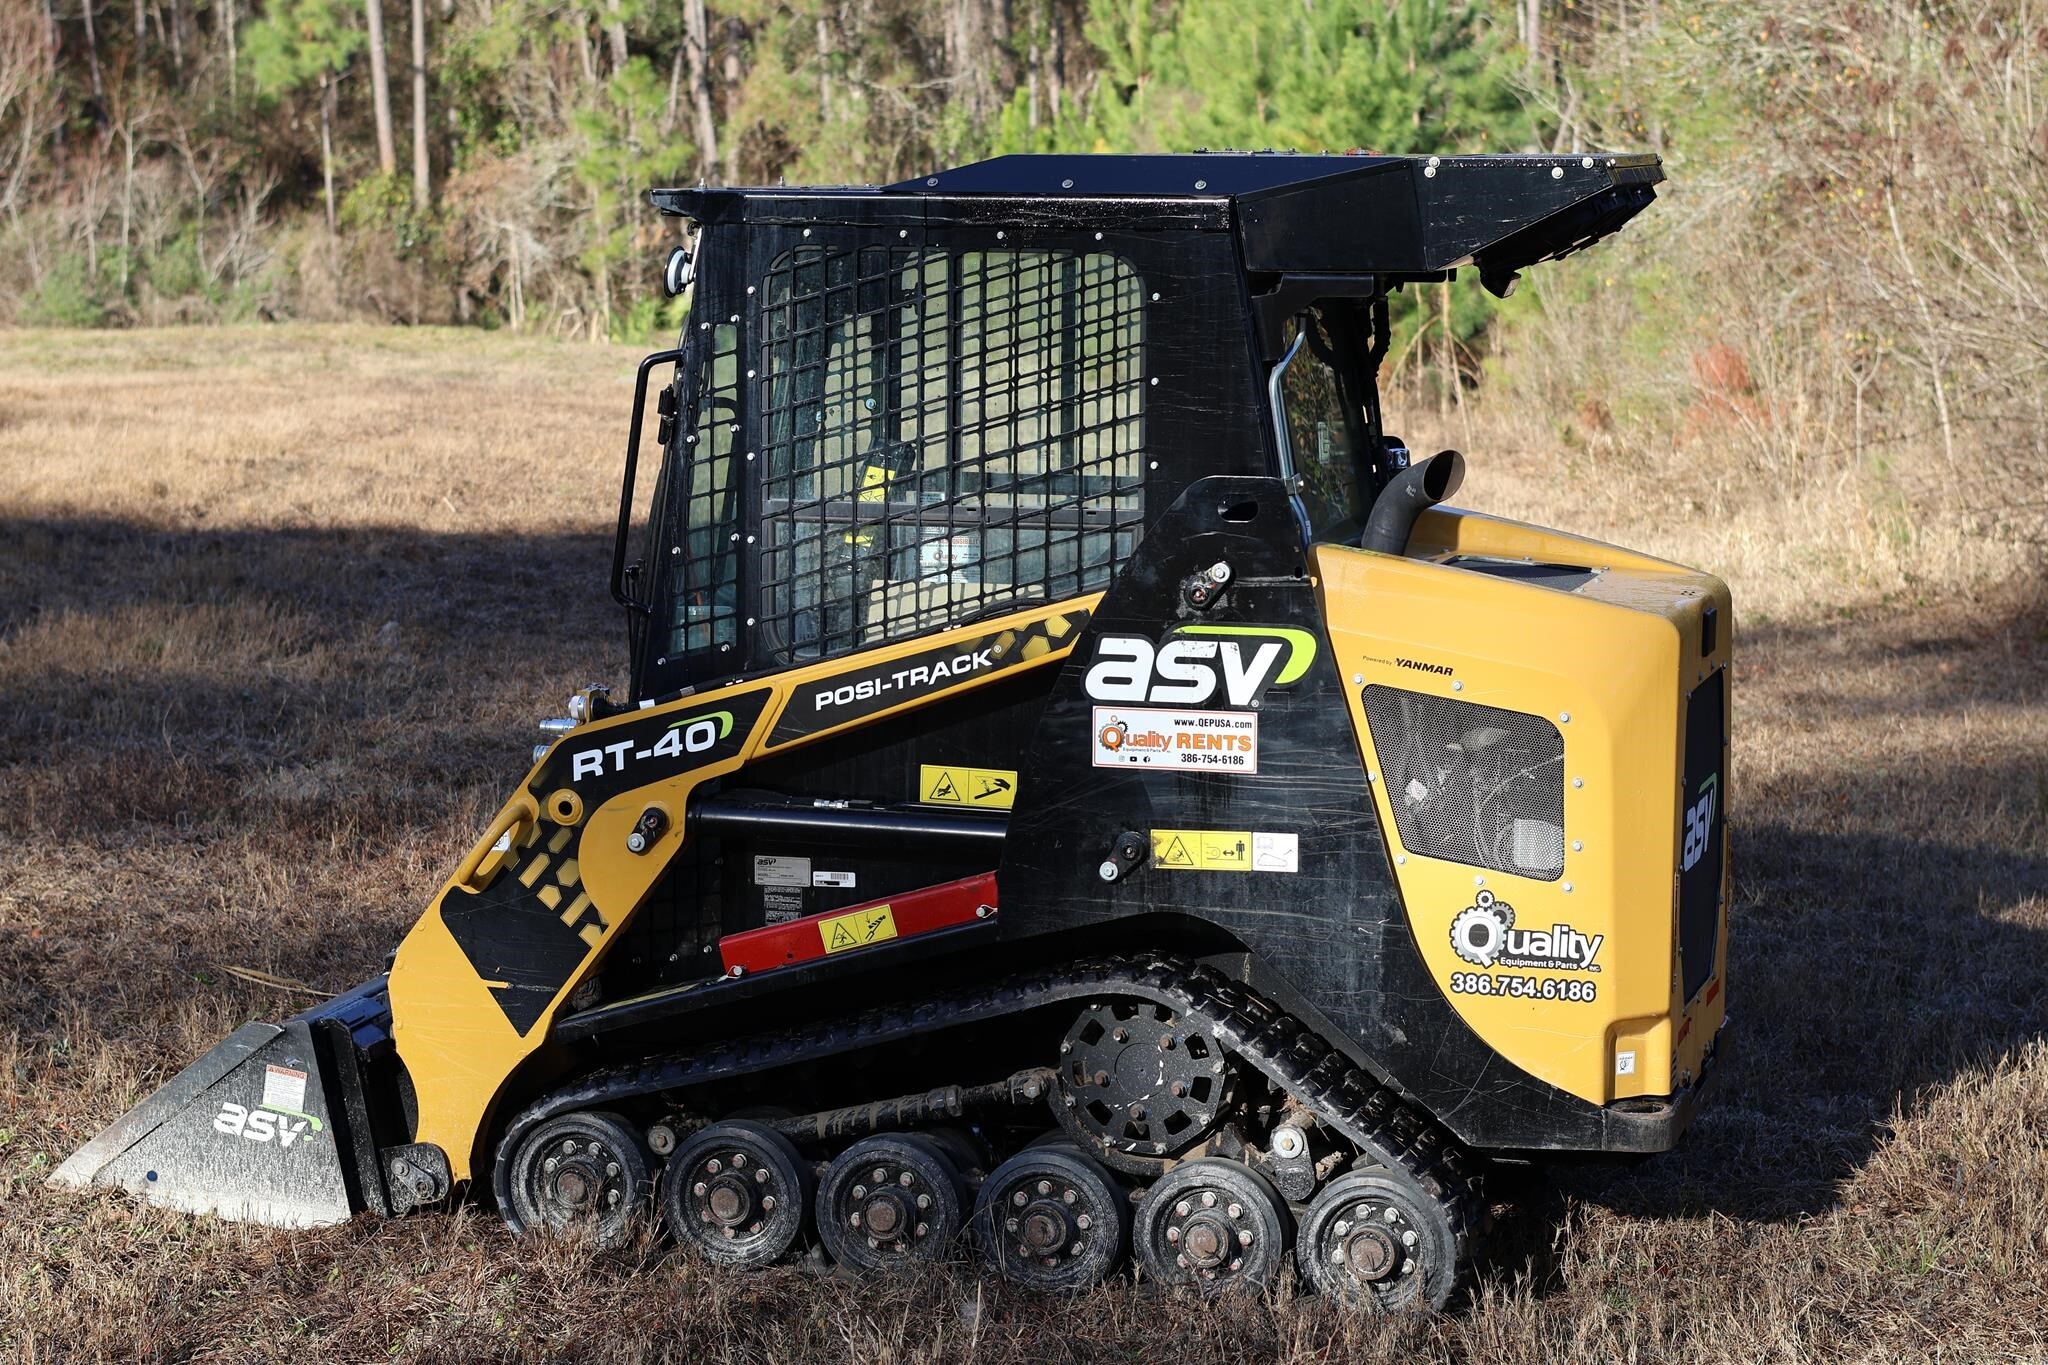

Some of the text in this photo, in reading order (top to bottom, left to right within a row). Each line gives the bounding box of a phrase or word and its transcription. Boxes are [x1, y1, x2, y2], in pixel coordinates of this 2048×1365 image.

[1395, 658, 1454, 676] YANMAR
[815, 648, 992, 711] POSI-TRACK
[1174, 717, 1253, 729] www.QEPUSA.com
[1101, 726, 1252, 753] Quality RENTS
[572, 720, 716, 782] RT-40
[1181, 753, 1244, 766] 386-754-6186
[1459, 914, 1604, 969] Quality
[1500, 957, 1547, 968] Equipment
[1548, 961, 1554, 969] &
[1555, 961, 1578, 970] Parts
[1451, 973, 1596, 1002] 386.754.6186
[275, 1068, 305, 1080] WARNING
